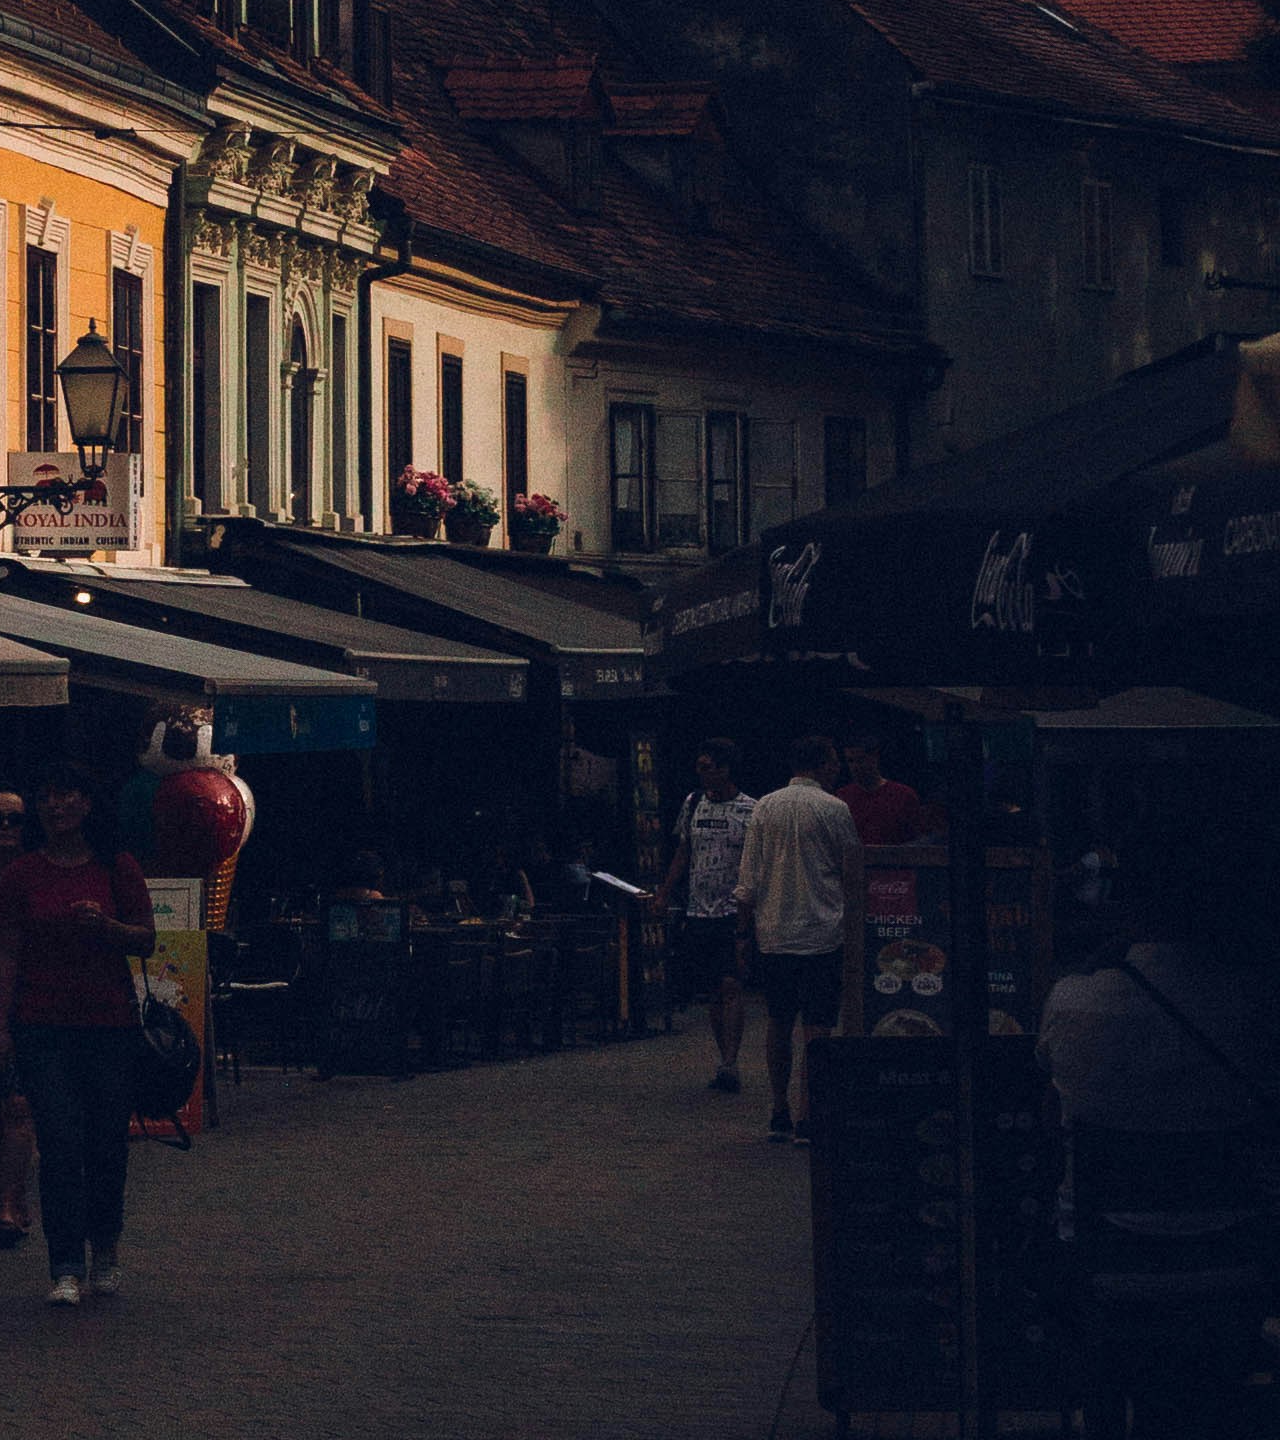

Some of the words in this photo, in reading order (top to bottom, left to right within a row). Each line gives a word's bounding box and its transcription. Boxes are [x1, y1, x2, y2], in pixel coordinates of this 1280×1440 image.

[16, 514, 70, 528] ROYAL
[73, 514, 128, 528] INDIA
[60, 537, 89, 546] INDIAN
[865, 914, 923, 926] CHICKEN
[877, 926, 911, 938] BEEF
